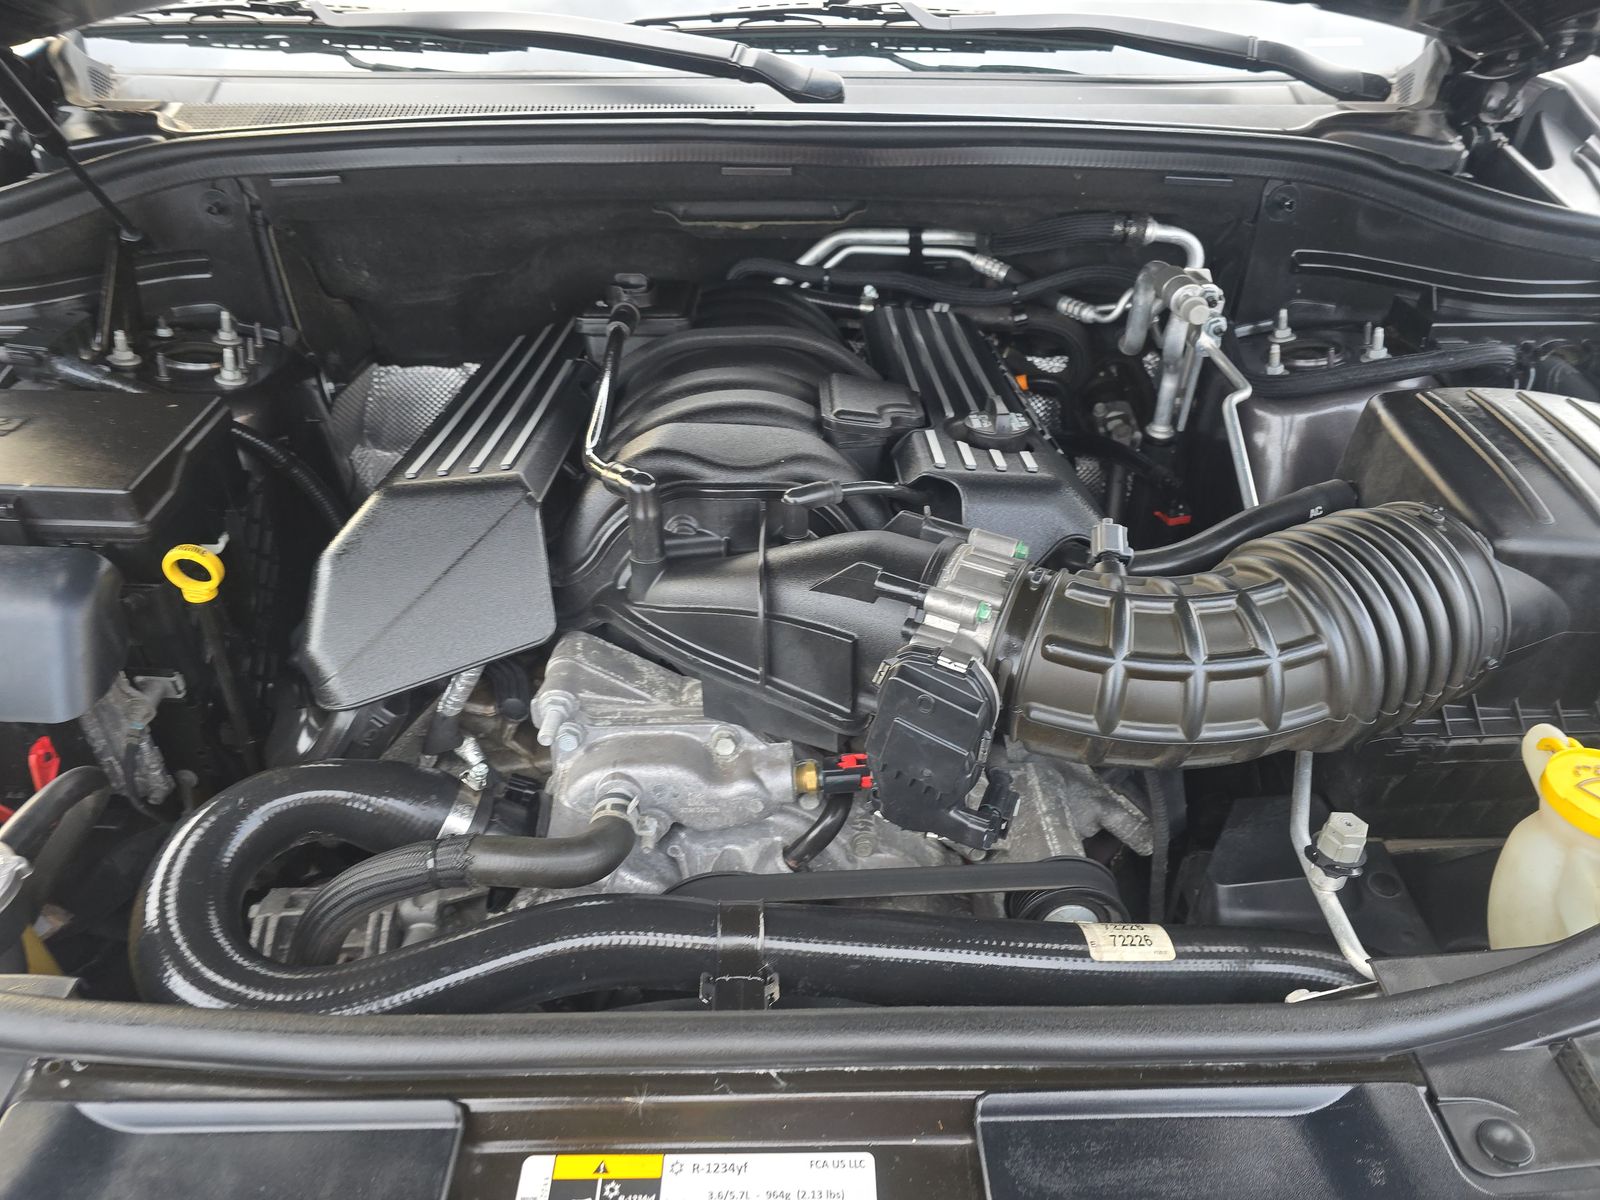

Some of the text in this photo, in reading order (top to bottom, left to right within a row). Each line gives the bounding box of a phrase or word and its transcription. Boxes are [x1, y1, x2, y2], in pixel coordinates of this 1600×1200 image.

[1109, 934, 1153, 946] 72226
[692, 1161, 748, 1176] R-1234yf
[809, 1160, 865, 1169] FCA US LLC
